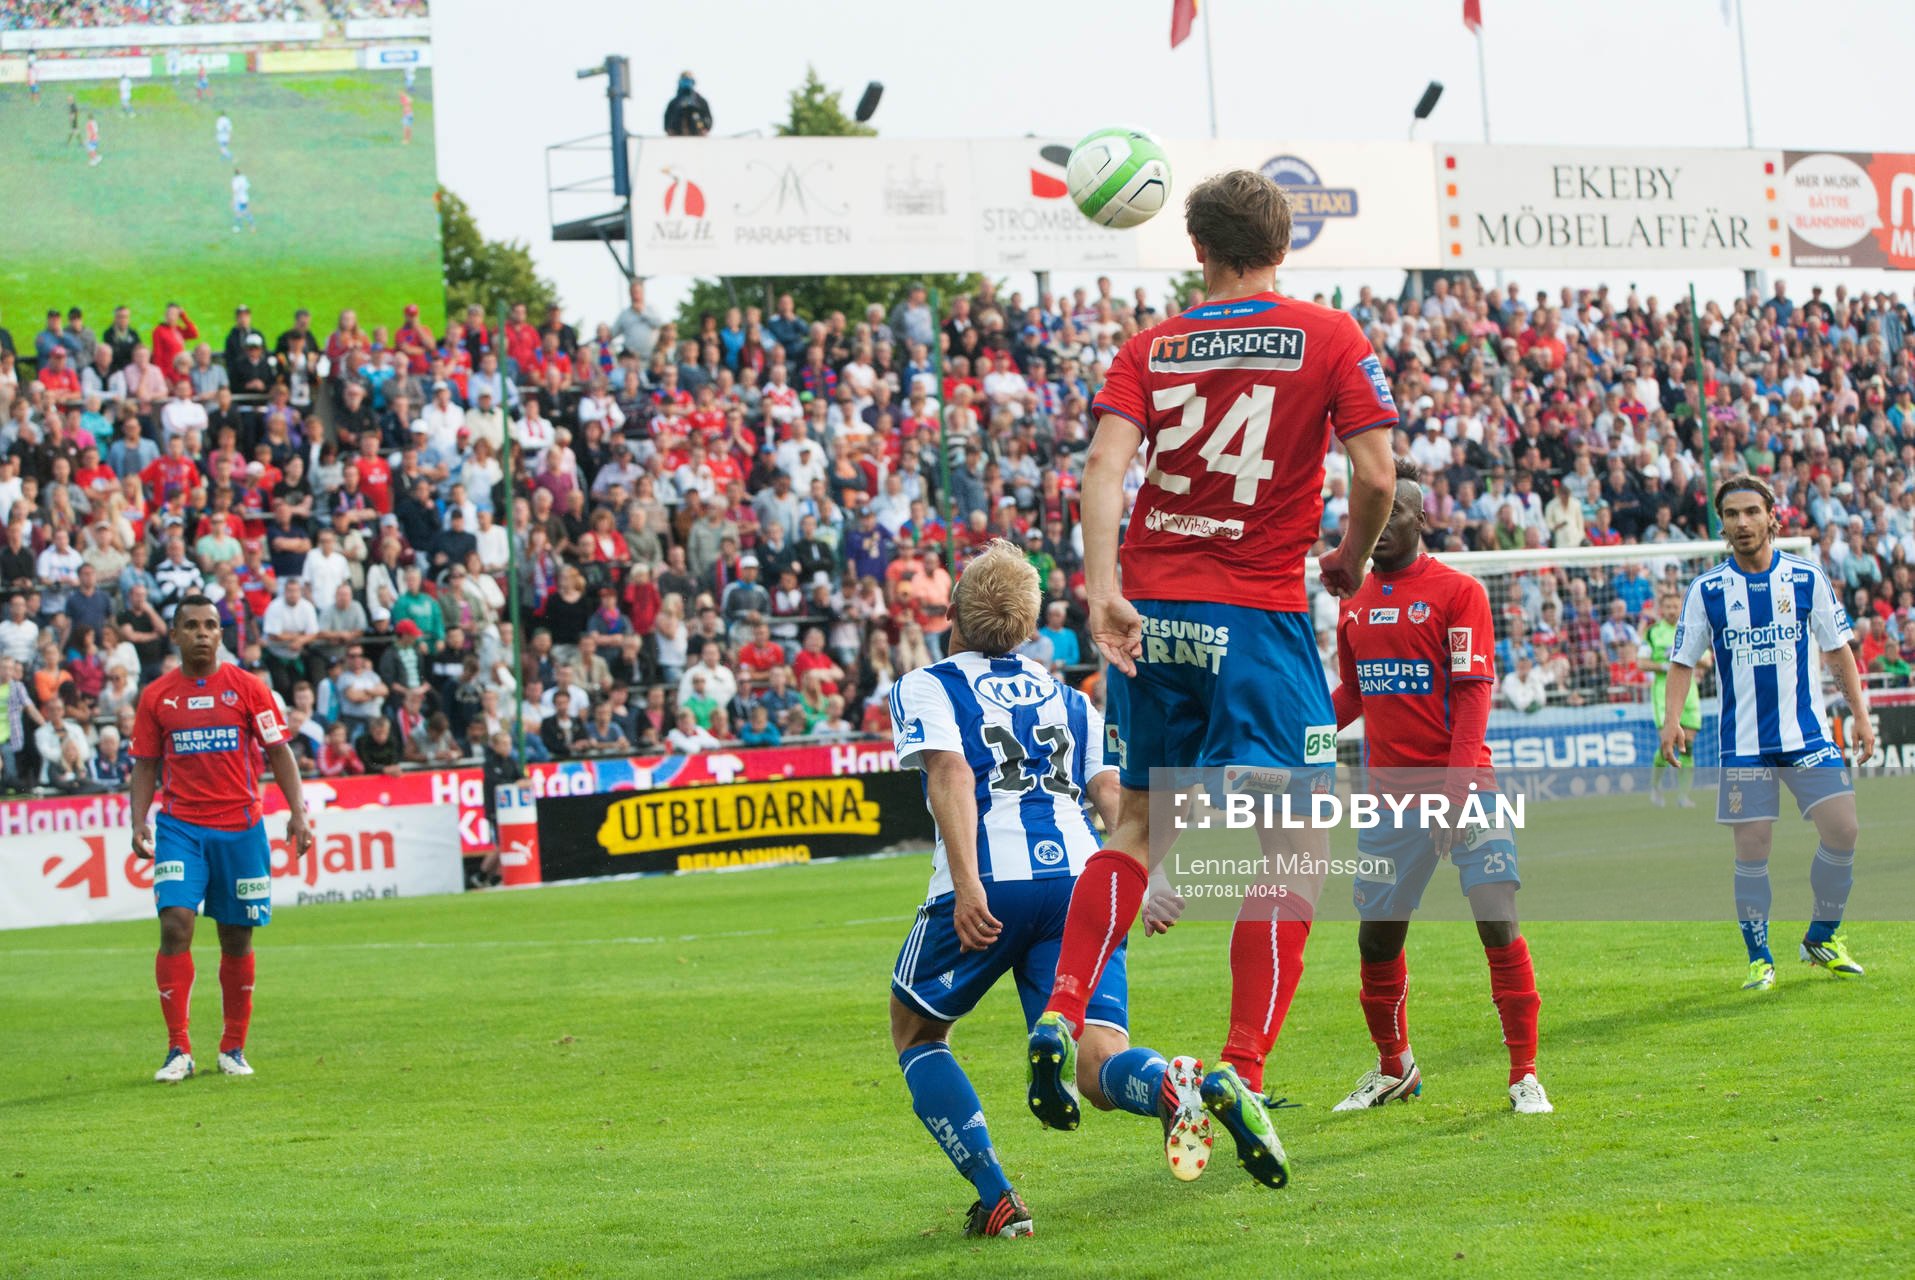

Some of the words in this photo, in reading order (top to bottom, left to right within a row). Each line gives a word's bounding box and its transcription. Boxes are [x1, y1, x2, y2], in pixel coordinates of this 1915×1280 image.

[1553, 164, 1681, 200] EKEBY
[1795, 175, 1819, 188] MER
[1824, 175, 1860, 189] MUSIK
[734, 225, 852, 245] PARAPETEN
[1477, 205, 1752, 248] MÖBELAFFÄR
[1191, 332, 1297, 357] GÅRDEN
[1145, 383, 1276, 506] 24
[1173, 515, 1240, 537] Wihlborgs
[1141, 615, 1229, 645] RESUNDS
[1724, 622, 1802, 648] Prioritet
[1736, 649, 1792, 666] Finans
[988, 681, 1044, 704] KIA
[172, 727, 238, 742] RESURS
[175, 740, 212, 752] BANK
[1489, 731, 1637, 768] ESURS
[1793, 746, 1841, 773] SEFA
[1727, 767, 1773, 781] SEFA
[620, 788, 861, 841] UTBILDARNA
[1483, 852, 1506, 874] 25
[298, 889, 345, 905] Proffs
[353, 885, 376, 901] på
[383, 882, 398, 898] el
[962, 1120, 986, 1131] adida
[925, 1116, 971, 1164] SKF
